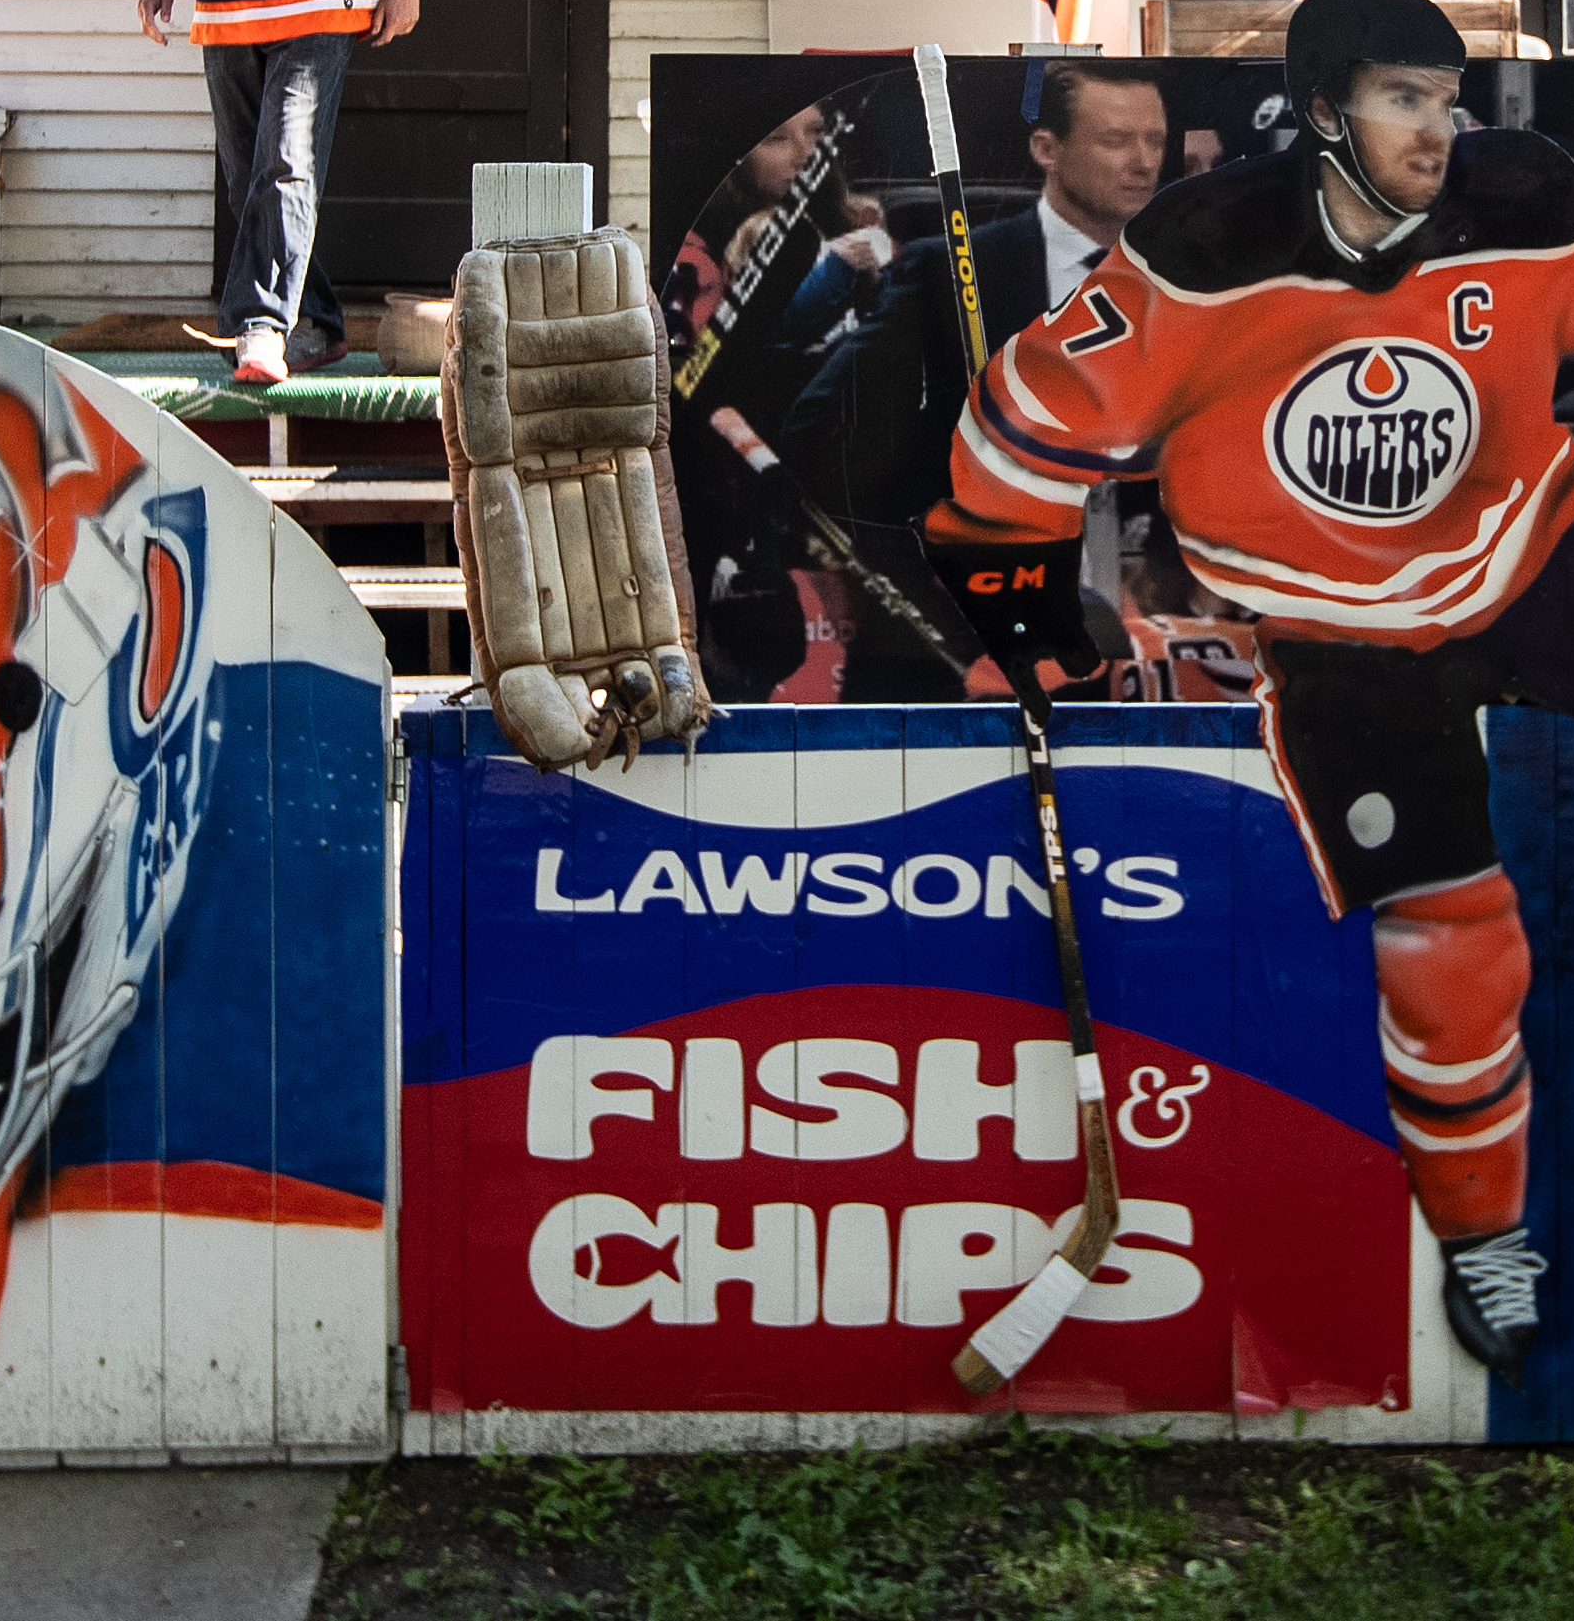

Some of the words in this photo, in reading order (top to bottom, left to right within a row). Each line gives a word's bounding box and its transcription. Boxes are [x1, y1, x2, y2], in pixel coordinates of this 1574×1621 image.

[951, 209, 978, 312] GOLD
[1042, 282, 1134, 360] 7
[1447, 281, 1494, 350] C
[1306, 407, 1455, 510] OILERS
[535, 847, 1185, 921] LAWSON'S
[1040, 804, 1066, 884] TPS
[528, 1035, 1079, 1161] FISH
[1117, 1064, 1211, 1148] &
[529, 1193, 1204, 1328] CHIPS
